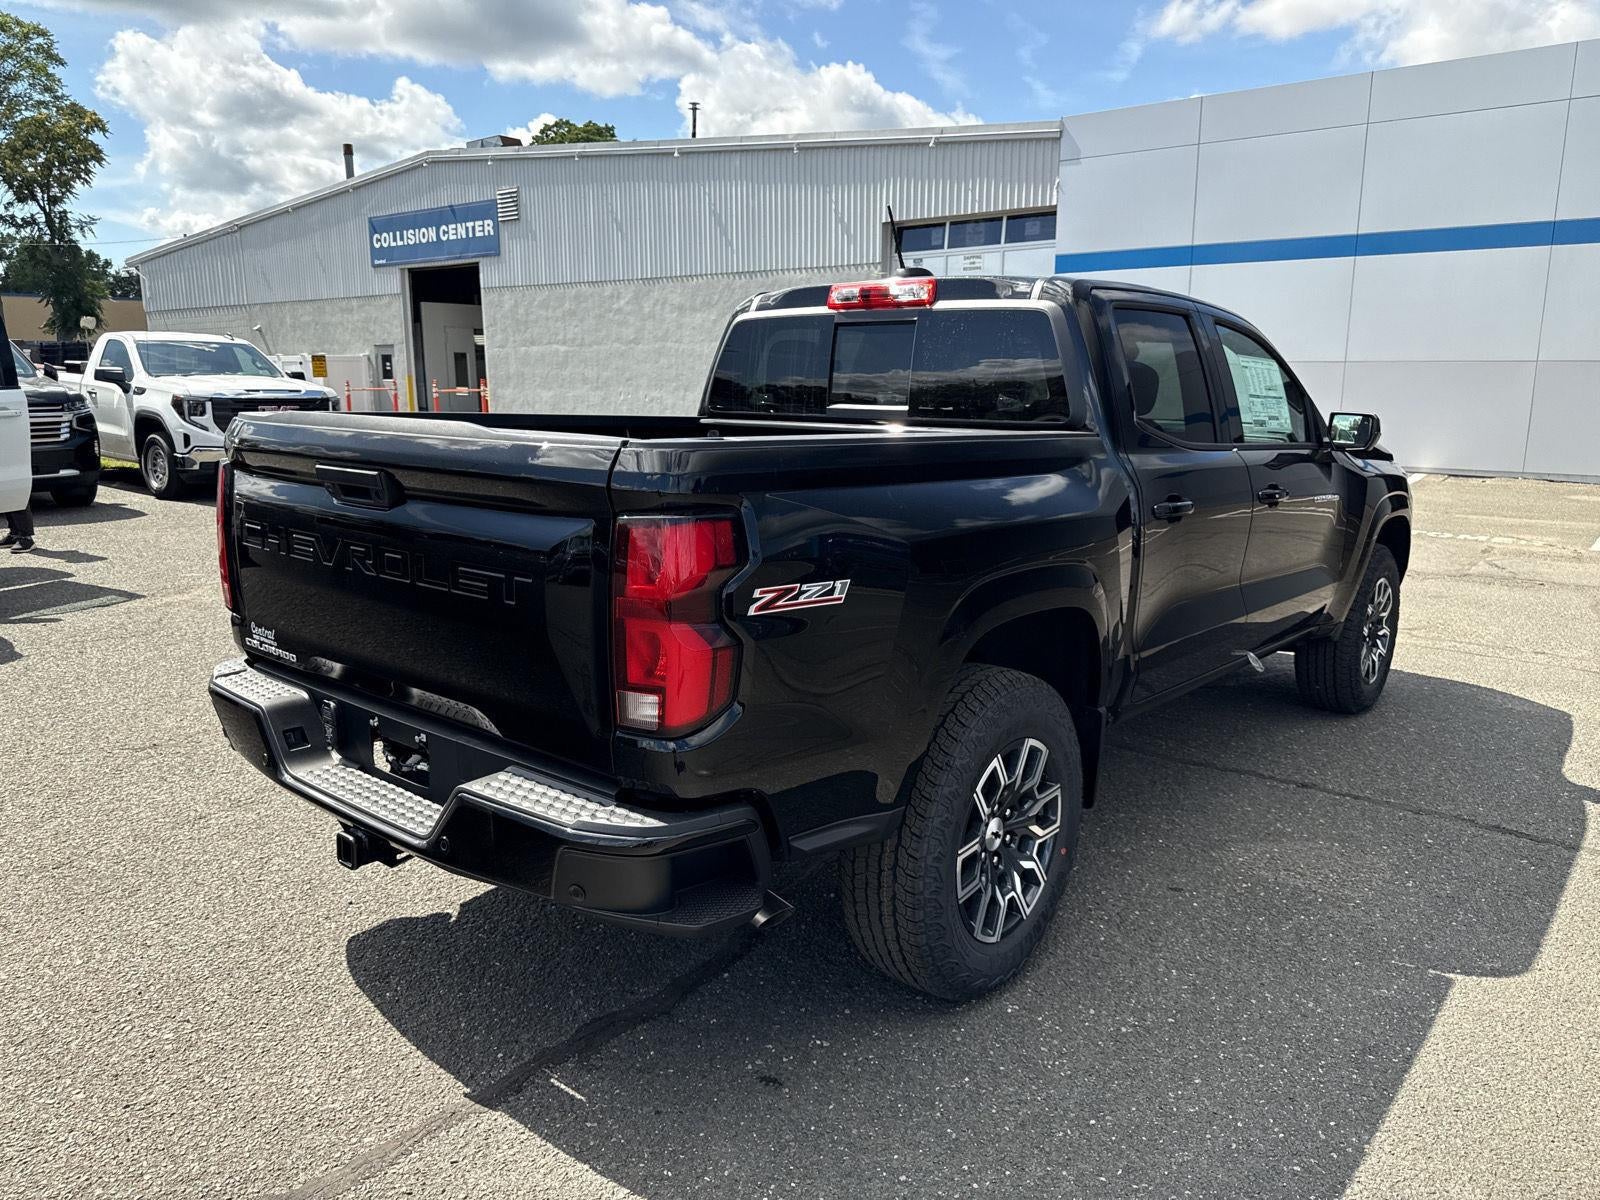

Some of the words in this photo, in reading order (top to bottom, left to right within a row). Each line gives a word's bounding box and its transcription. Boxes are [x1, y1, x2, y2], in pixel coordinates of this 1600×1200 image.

[372, 226, 437, 249] COLLISION
[439, 219, 495, 241] CENTER
[242, 518, 533, 605] CHEVROLET
[747, 579, 851, 616] Z71
[250, 621, 275, 640] Central
[245, 637, 297, 662] COLORADO
